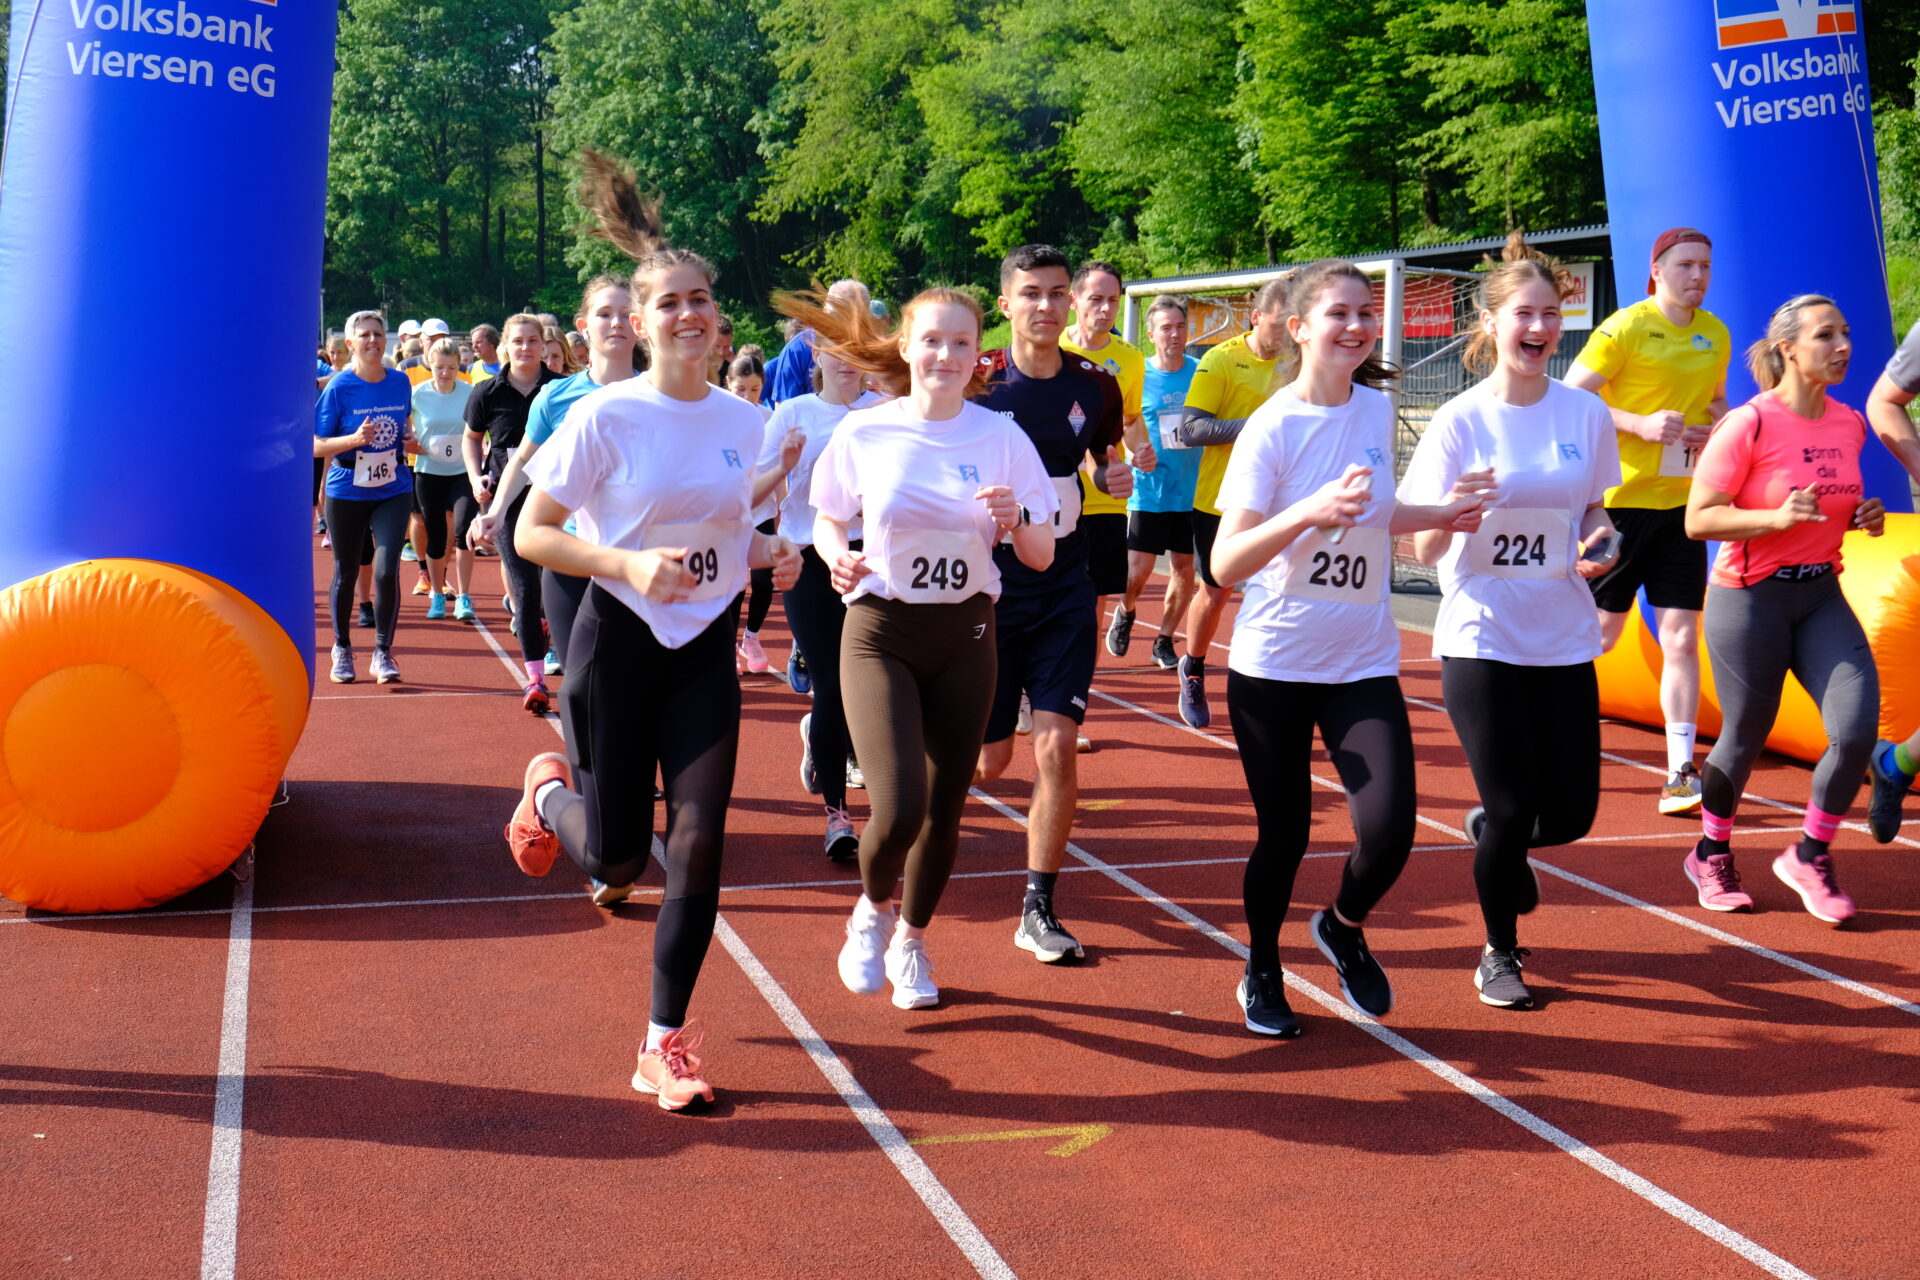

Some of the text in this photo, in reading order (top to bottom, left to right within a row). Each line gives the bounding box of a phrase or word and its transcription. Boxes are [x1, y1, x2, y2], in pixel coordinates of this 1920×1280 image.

[69, 0, 274, 52] Volksbank
[66, 41, 276, 98] Viersen eG
[1711, 44, 1861, 90] Volksbank
[1715, 83, 1866, 129] Viersen eG
[445, 444, 453, 457] 6
[367, 462, 389, 481] 146
[682, 547, 719, 586] 99
[1492, 534, 1546, 566] 224
[911, 556, 969, 590] 249
[1309, 551, 1367, 590] 230
